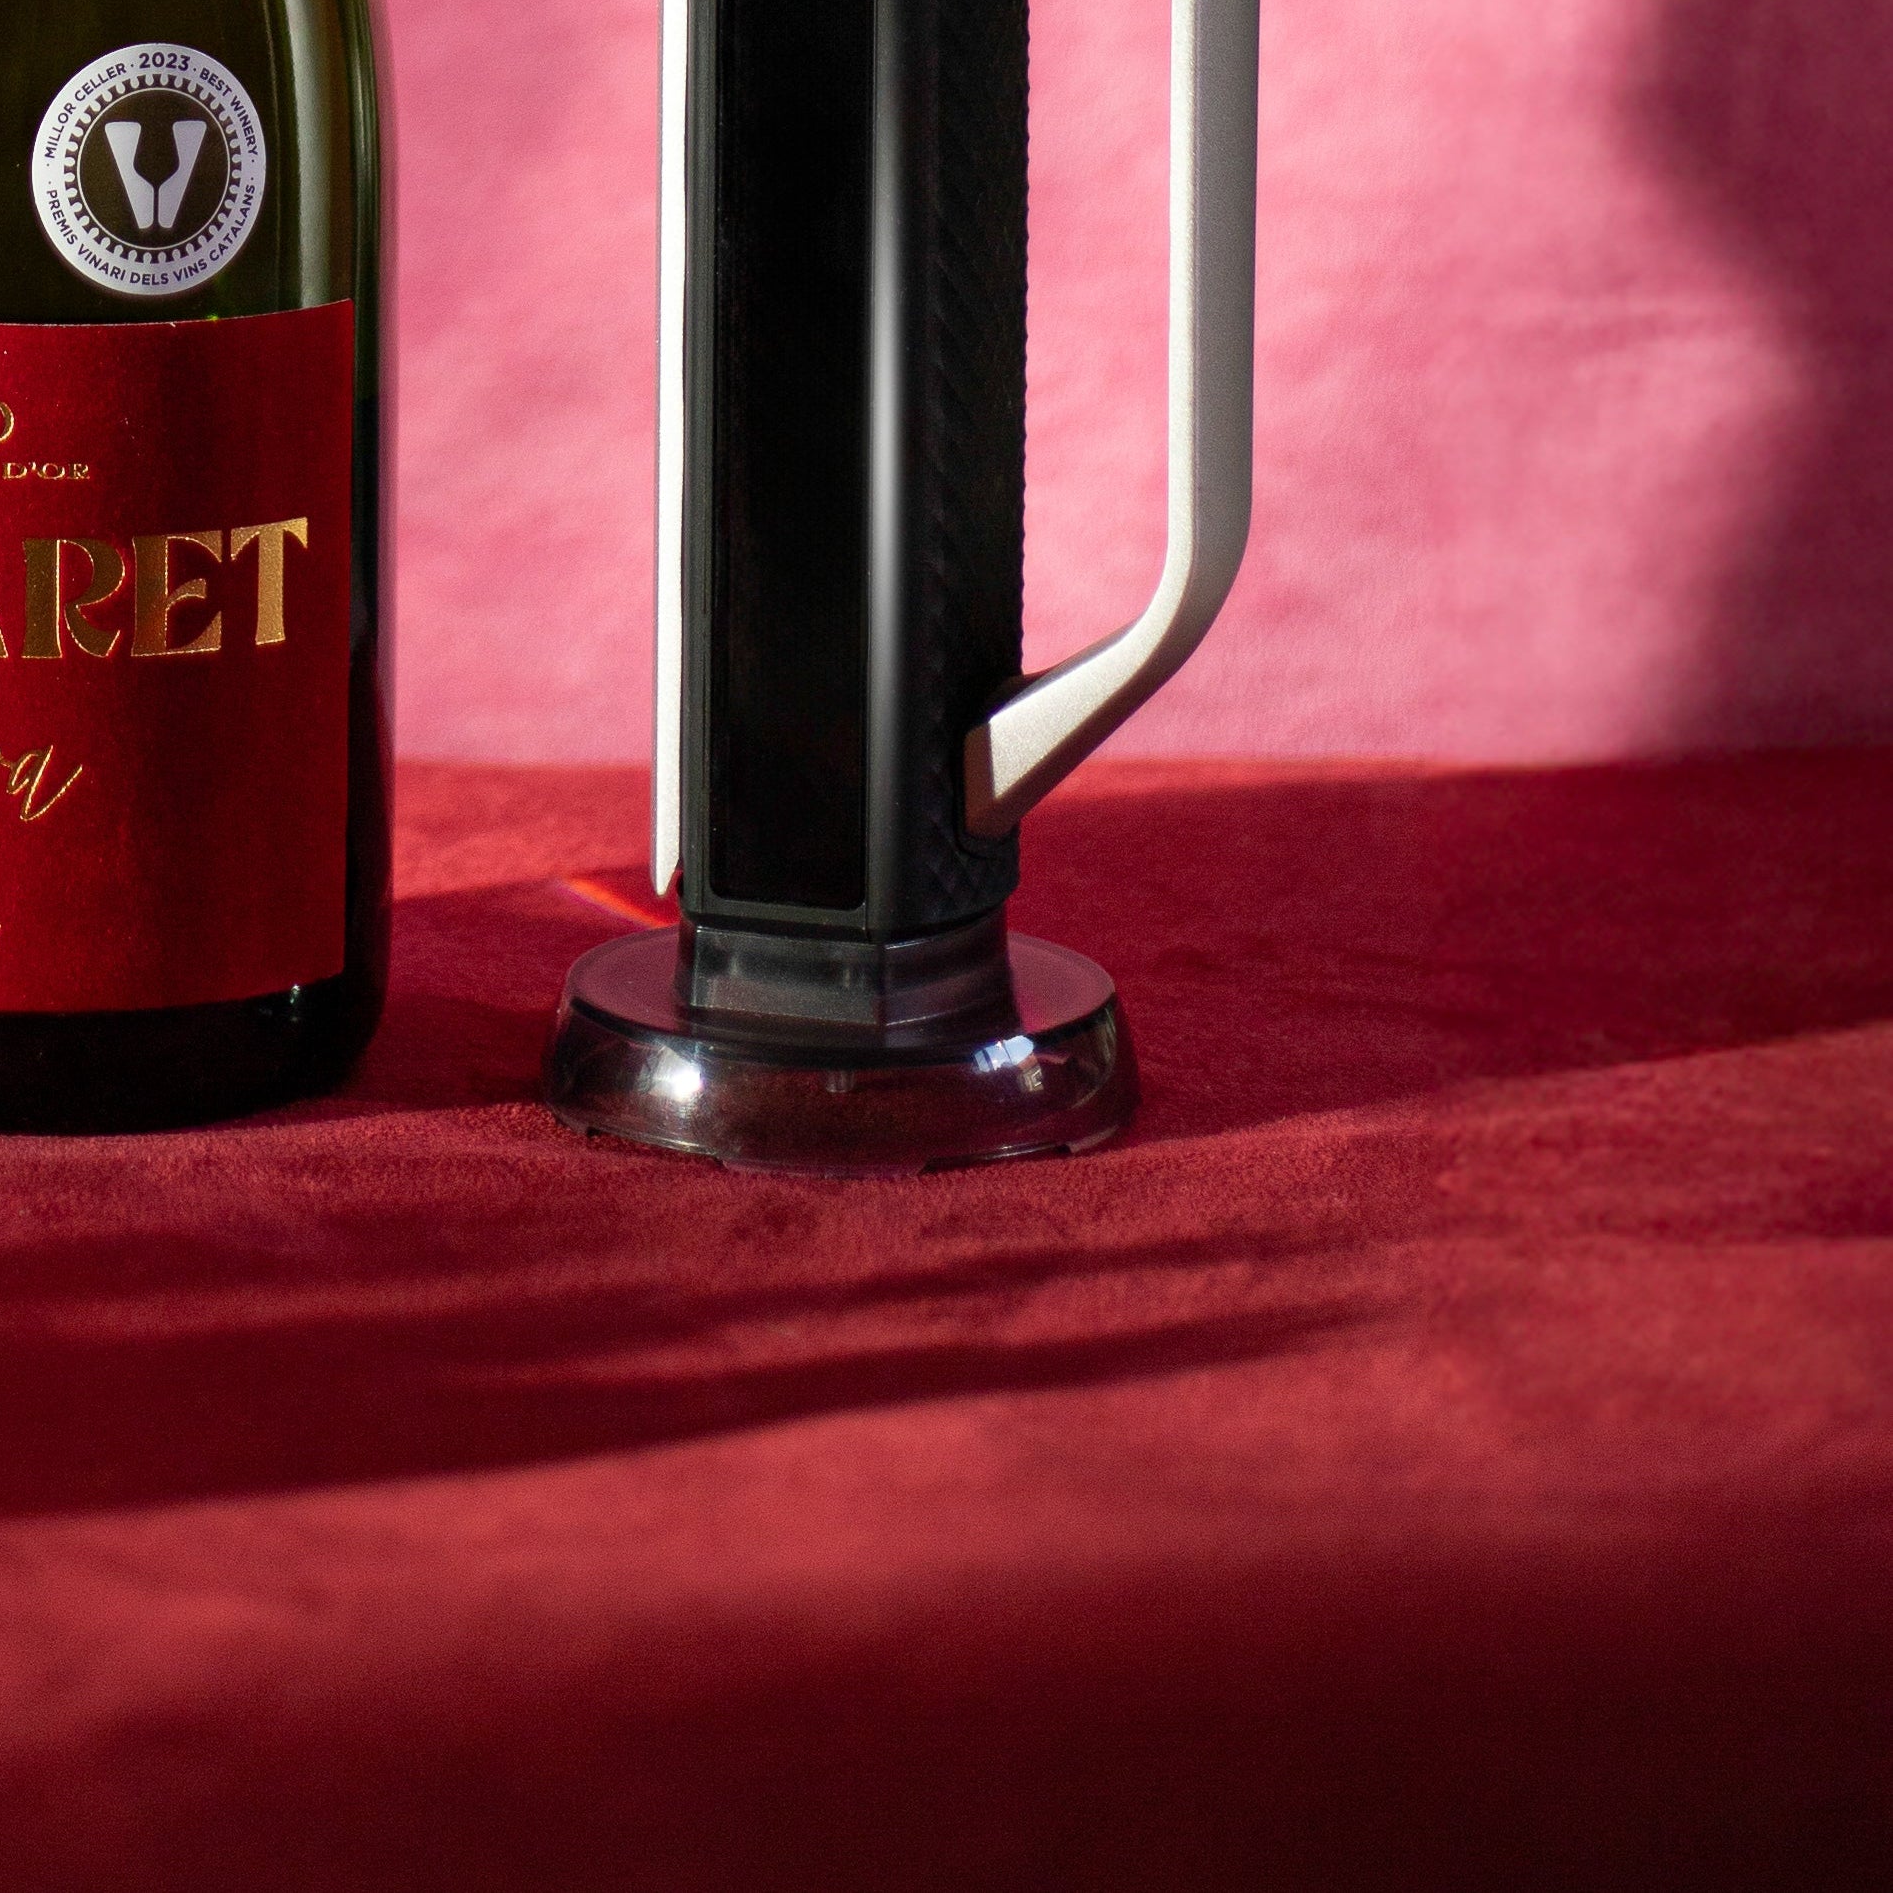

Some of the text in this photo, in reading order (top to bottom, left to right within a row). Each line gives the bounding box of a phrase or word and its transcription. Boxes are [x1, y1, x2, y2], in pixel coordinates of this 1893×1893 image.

[45, 52, 259, 159] MILLOR CELLER 2023 BEST WINERY
[47, 185, 256, 285] PREMIS VINARI DELS VINS CATALANS
[2, 460, 91, 481] D'OR
